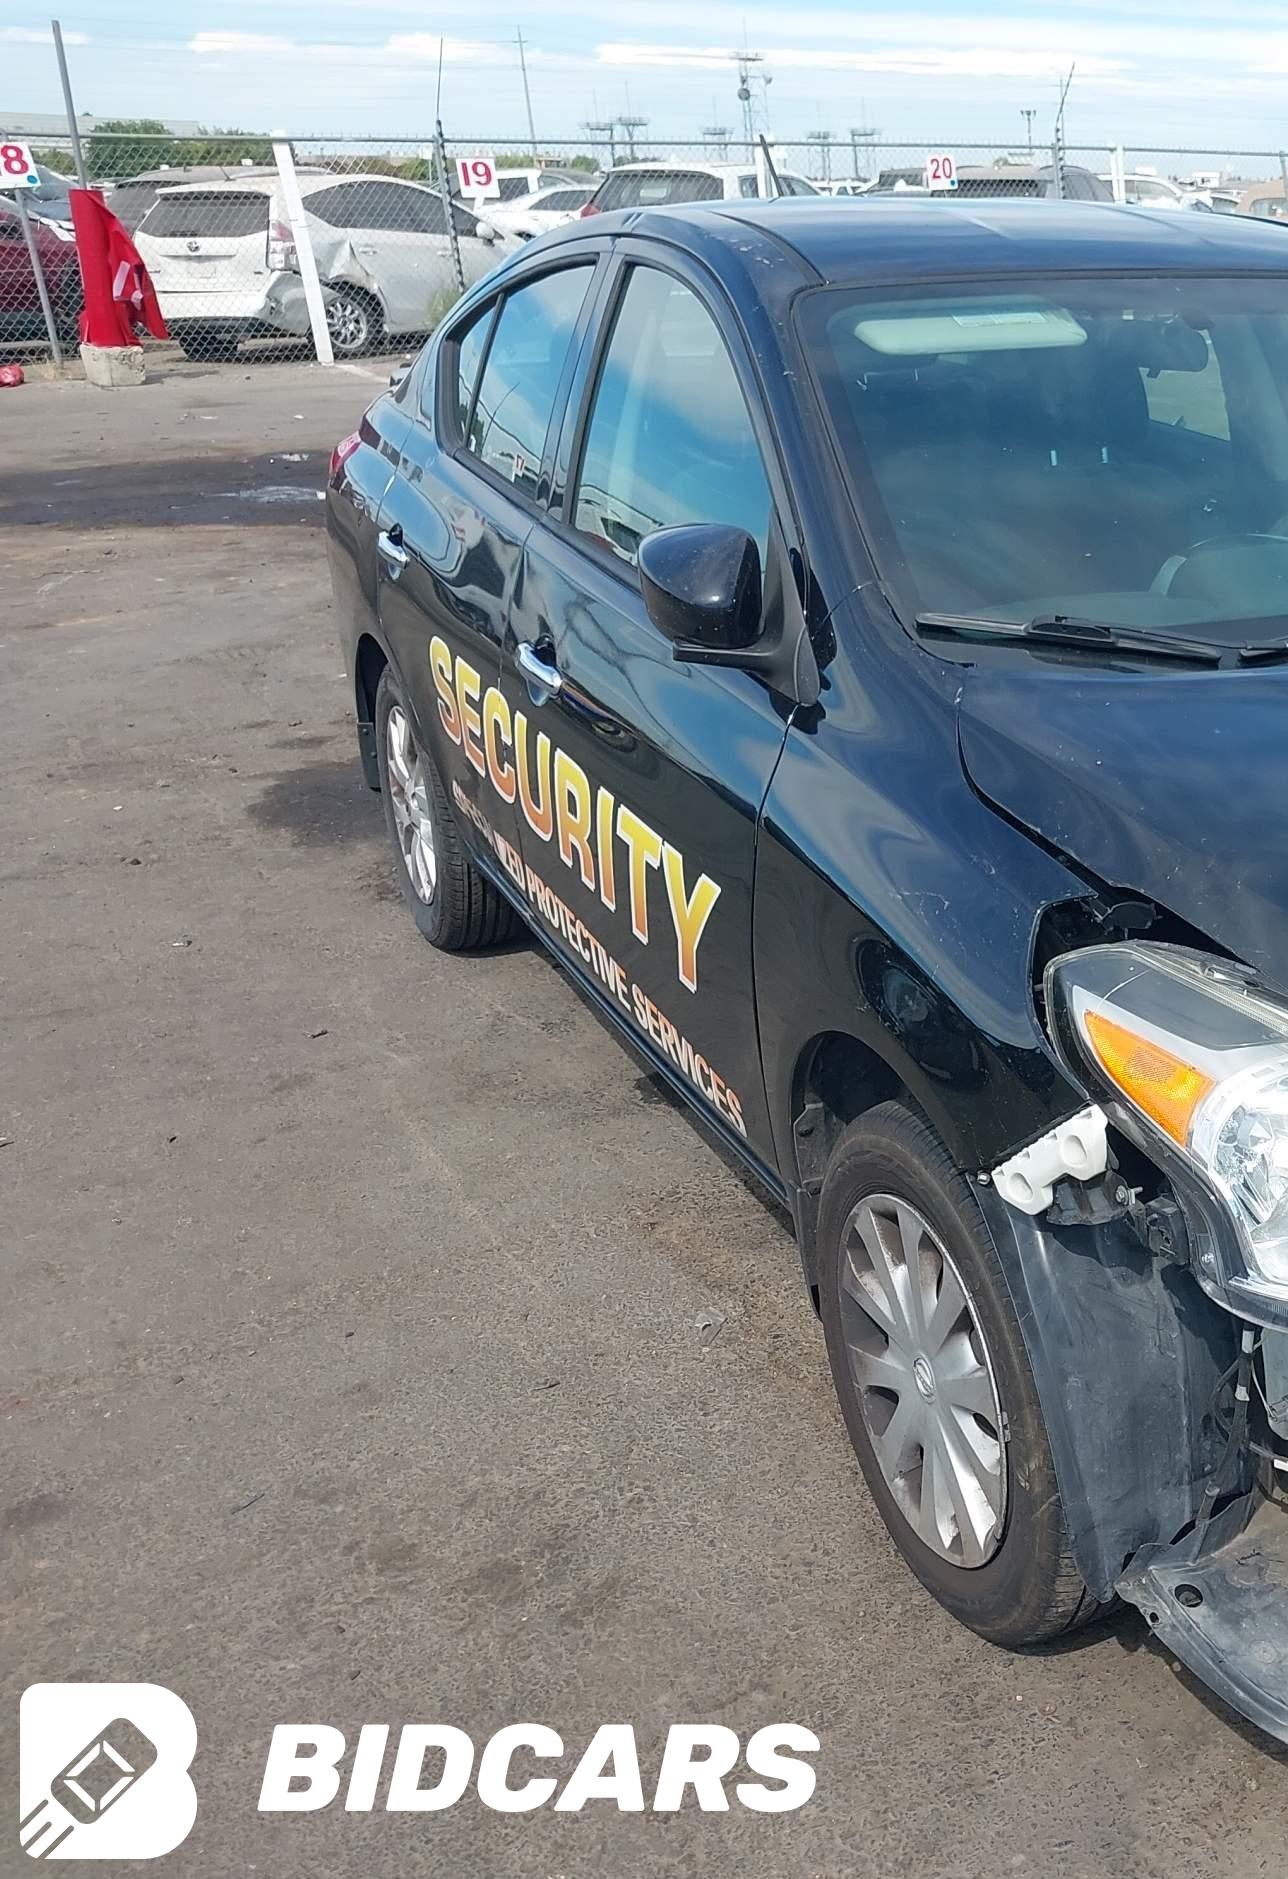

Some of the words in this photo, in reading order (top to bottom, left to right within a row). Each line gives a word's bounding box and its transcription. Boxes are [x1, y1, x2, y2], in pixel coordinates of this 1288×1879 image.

[0, 144, 29, 175] 8
[461, 161, 492, 187] 19
[930, 157, 953, 180] 20
[429, 635, 721, 994] SECURITY
[524, 863, 632, 1013] PROTECTIVE
[631, 983, 748, 1138] SERVICES
